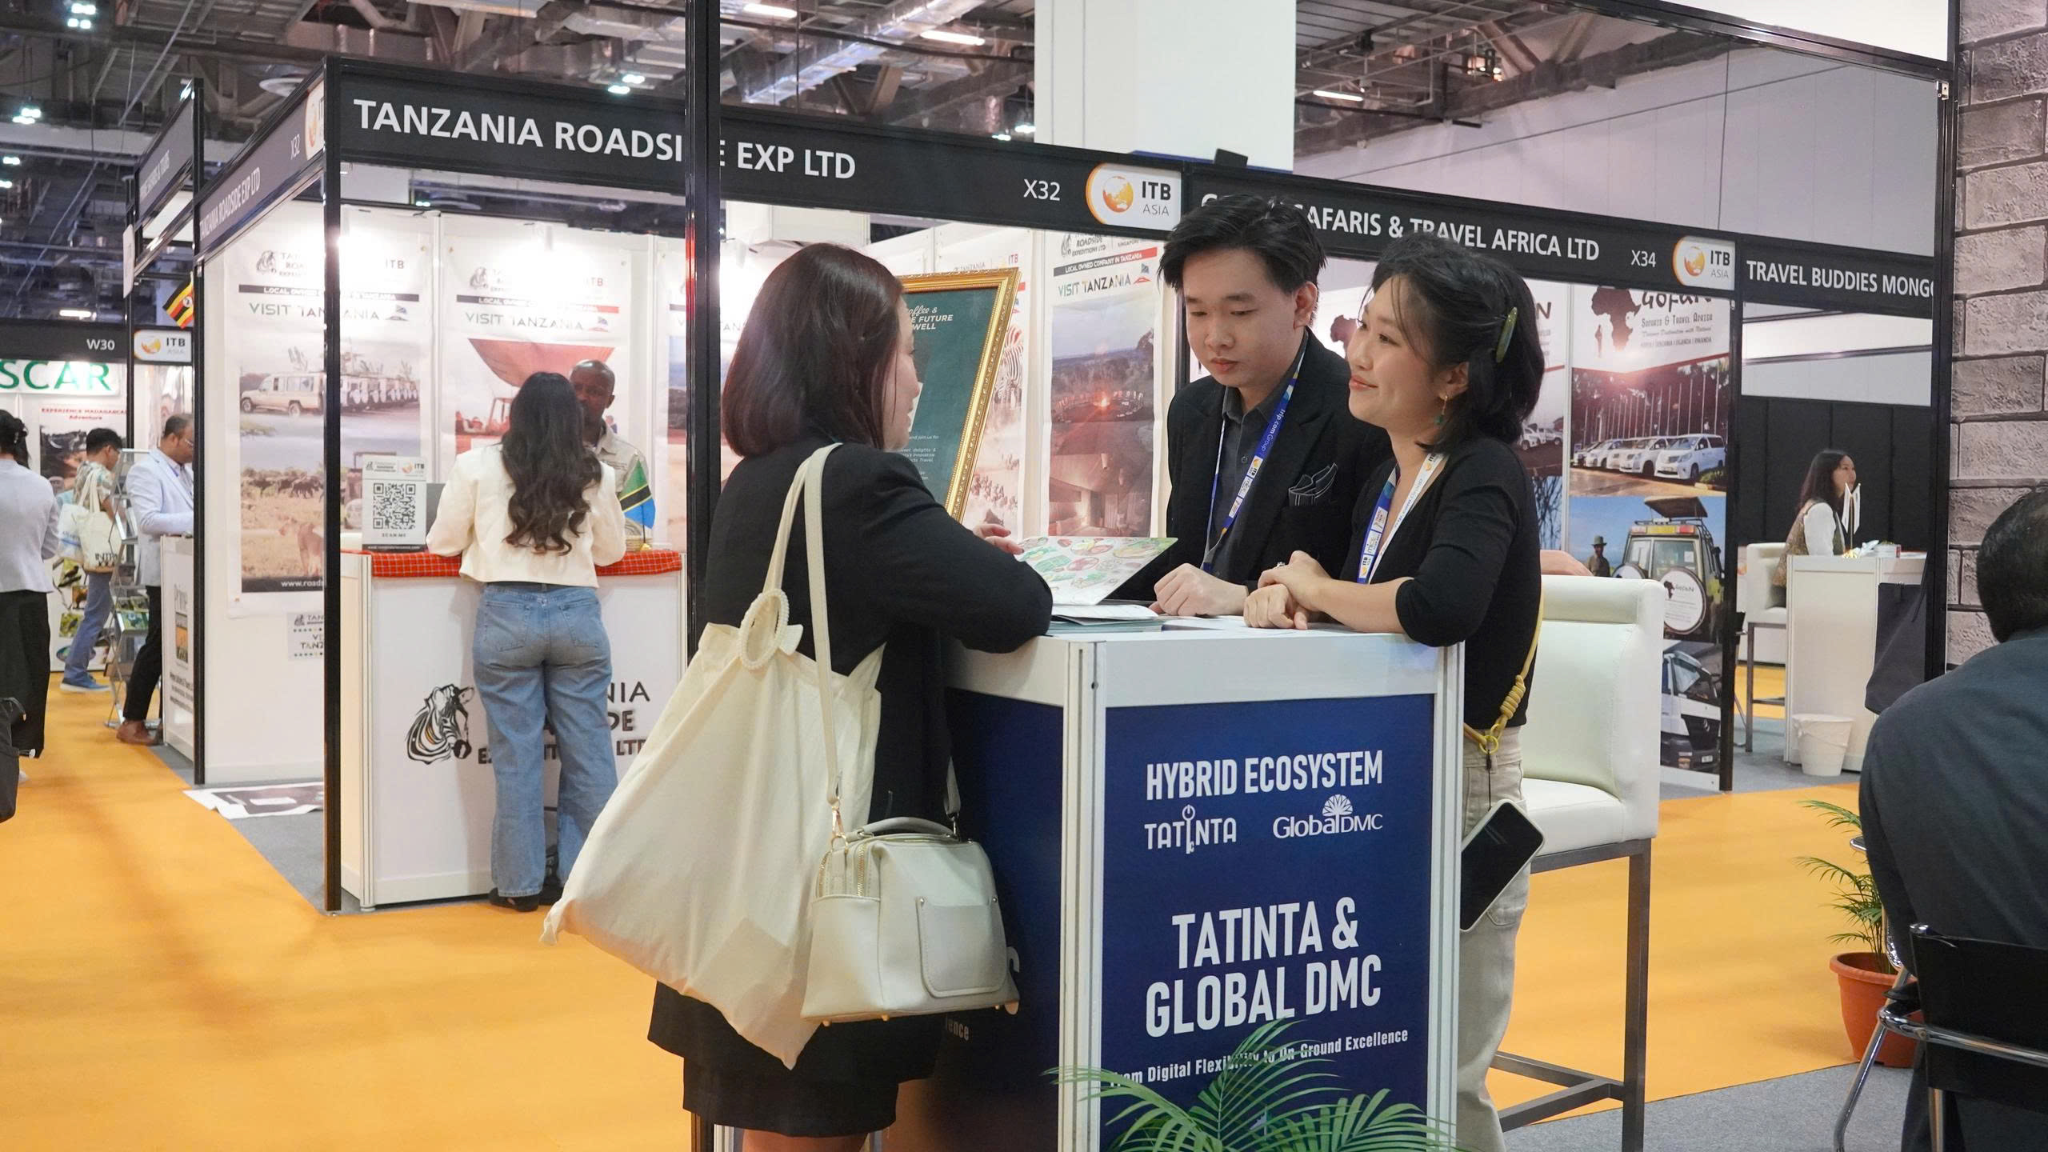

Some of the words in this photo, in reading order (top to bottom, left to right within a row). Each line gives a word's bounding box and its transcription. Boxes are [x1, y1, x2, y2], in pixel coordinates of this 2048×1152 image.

[353, 98, 544, 148] TANZANIA
[555, 121, 726, 166] ROADSI
[737, 141, 794, 173] EXP
[804, 149, 856, 179] LTD
[1023, 178, 1061, 202] X32
[1142, 180, 1172, 201] ITB
[1142, 204, 1170, 216] ASIA
[1294, 203, 1382, 236] AFARIS
[1388, 215, 1404, 238] &
[1491, 228, 1562, 258] AFRICA
[1567, 238, 1600, 261] LTD
[1008, 254, 1019, 264] ITB
[1630, 250, 1656, 268] X34
[1710, 250, 1731, 266] ITB
[587, 277, 604, 286] TB
[1710, 268, 1730, 278] ASIA
[1746, 260, 1808, 286] TRAVEL
[1812, 266, 1878, 293] BUDDIES
[1058, 282, 1080, 297] VISIT
[1082, 272, 1132, 293] TANZANIA
[248, 303, 291, 316] VISIT
[297, 305, 380, 320] TANANIA
[465, 312, 504, 325] VISIT
[908, 305, 930, 316] offee
[918, 314, 954, 323] FUTURE
[86, 338, 116, 350] W30
[166, 338, 186, 347] ITB
[1146, 759, 1238, 800] HYBRID
[1244, 750, 1383, 794] ECOSYSTEM
[1144, 806, 1237, 853] TATINTA
[1172, 901, 1323, 969] TATINTA
[1332, 896, 1359, 950] &
[1146, 966, 1295, 1038] GLOBAL
[1306, 954, 1382, 1016] DMC
[1148, 1060, 1191, 1082] Digital
[1346, 1030, 1408, 1051] Excellence
